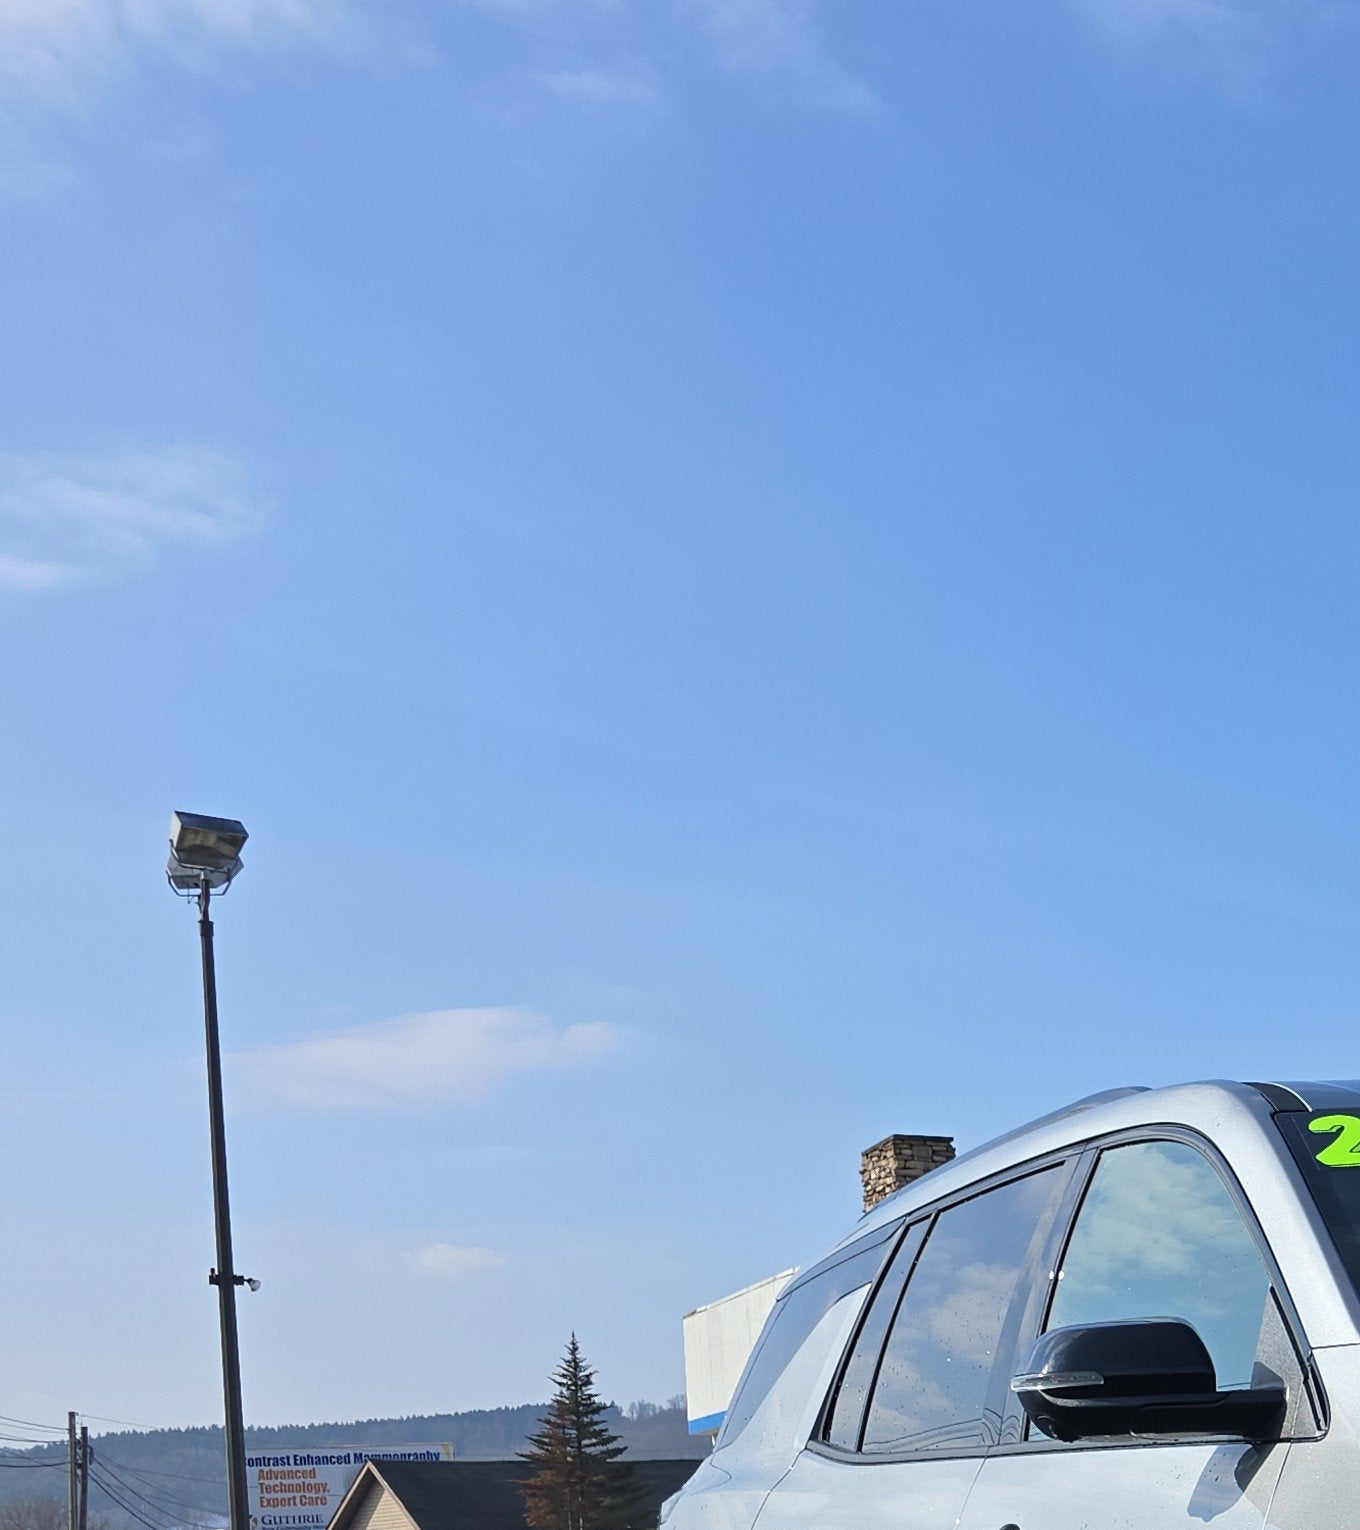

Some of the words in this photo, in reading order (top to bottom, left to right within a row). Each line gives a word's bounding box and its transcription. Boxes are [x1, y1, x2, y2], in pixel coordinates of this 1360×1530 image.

[247, 1455, 291, 1468] ontrast
[293, 1452, 351, 1467] Enhanced
[258, 1467, 317, 1480] Advanced
[258, 1481, 330, 1494] Technology.
[260, 1496, 298, 1508] Expert
[300, 1495, 327, 1506] Care
[261, 1514, 324, 1525] GUTHRIE
